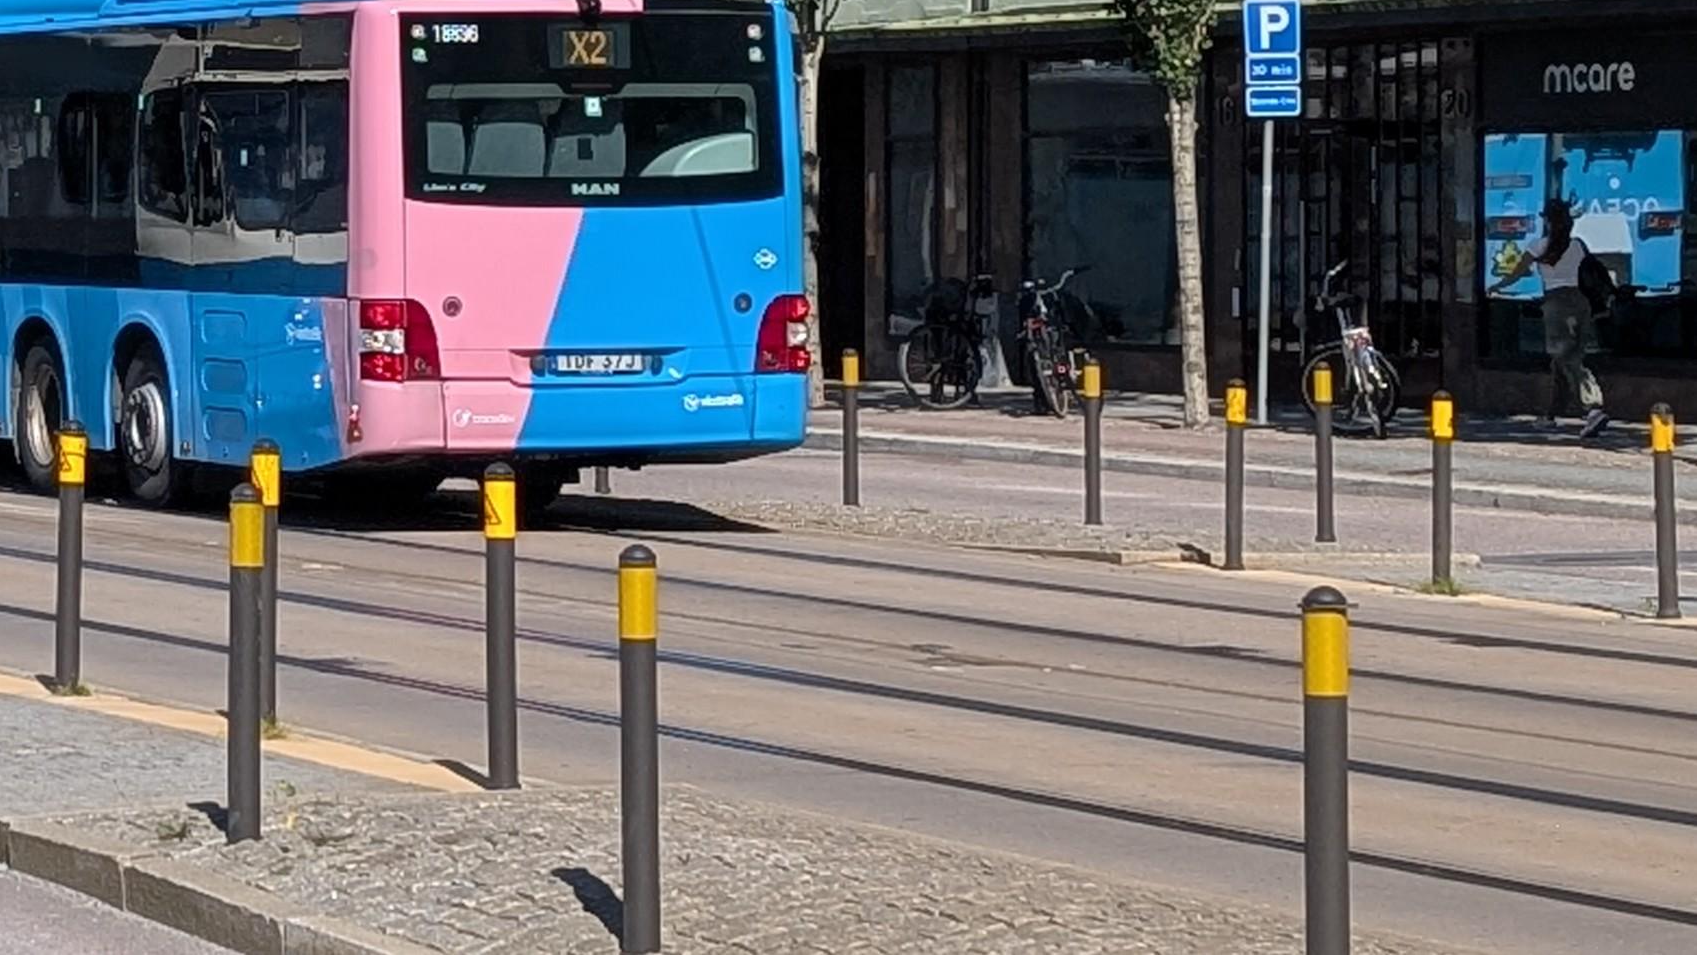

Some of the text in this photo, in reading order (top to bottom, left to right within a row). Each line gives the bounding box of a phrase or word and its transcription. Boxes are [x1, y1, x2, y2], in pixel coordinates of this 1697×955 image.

[1259, 4, 1290, 50] P
[568, 30, 607, 65] X2
[1542, 61, 1636, 93] mcare
[571, 182, 621, 196] MAN
